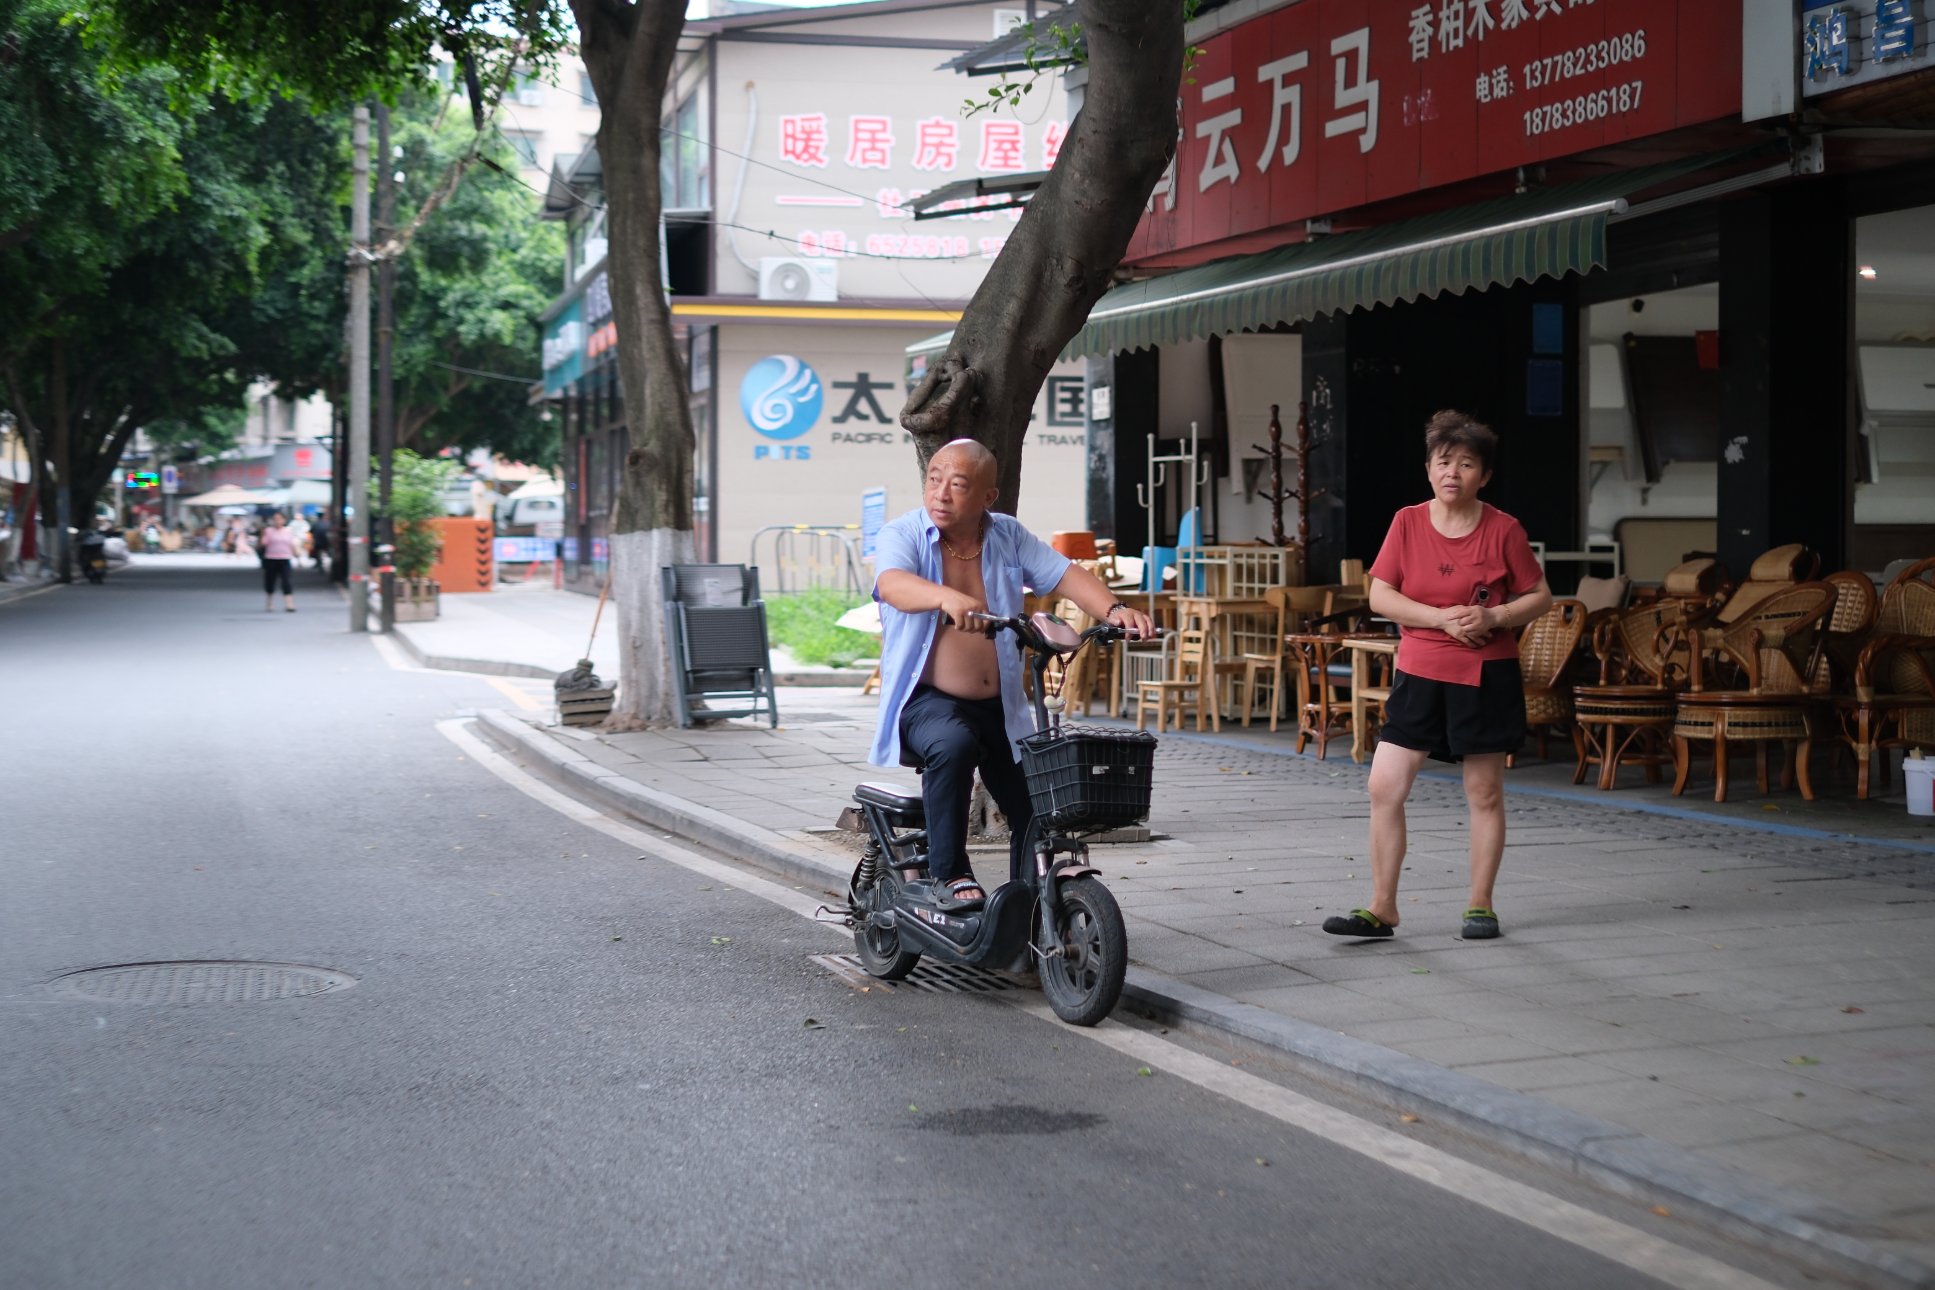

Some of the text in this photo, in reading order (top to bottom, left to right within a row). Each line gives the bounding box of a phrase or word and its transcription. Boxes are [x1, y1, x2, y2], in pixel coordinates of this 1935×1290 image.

[1523, 29, 1646, 90] 13778233086
[1146, 26, 1380, 213] 云万马
[1523, 80, 1642, 136] 18783866187
[831, 432, 894, 445] PACIFIC
